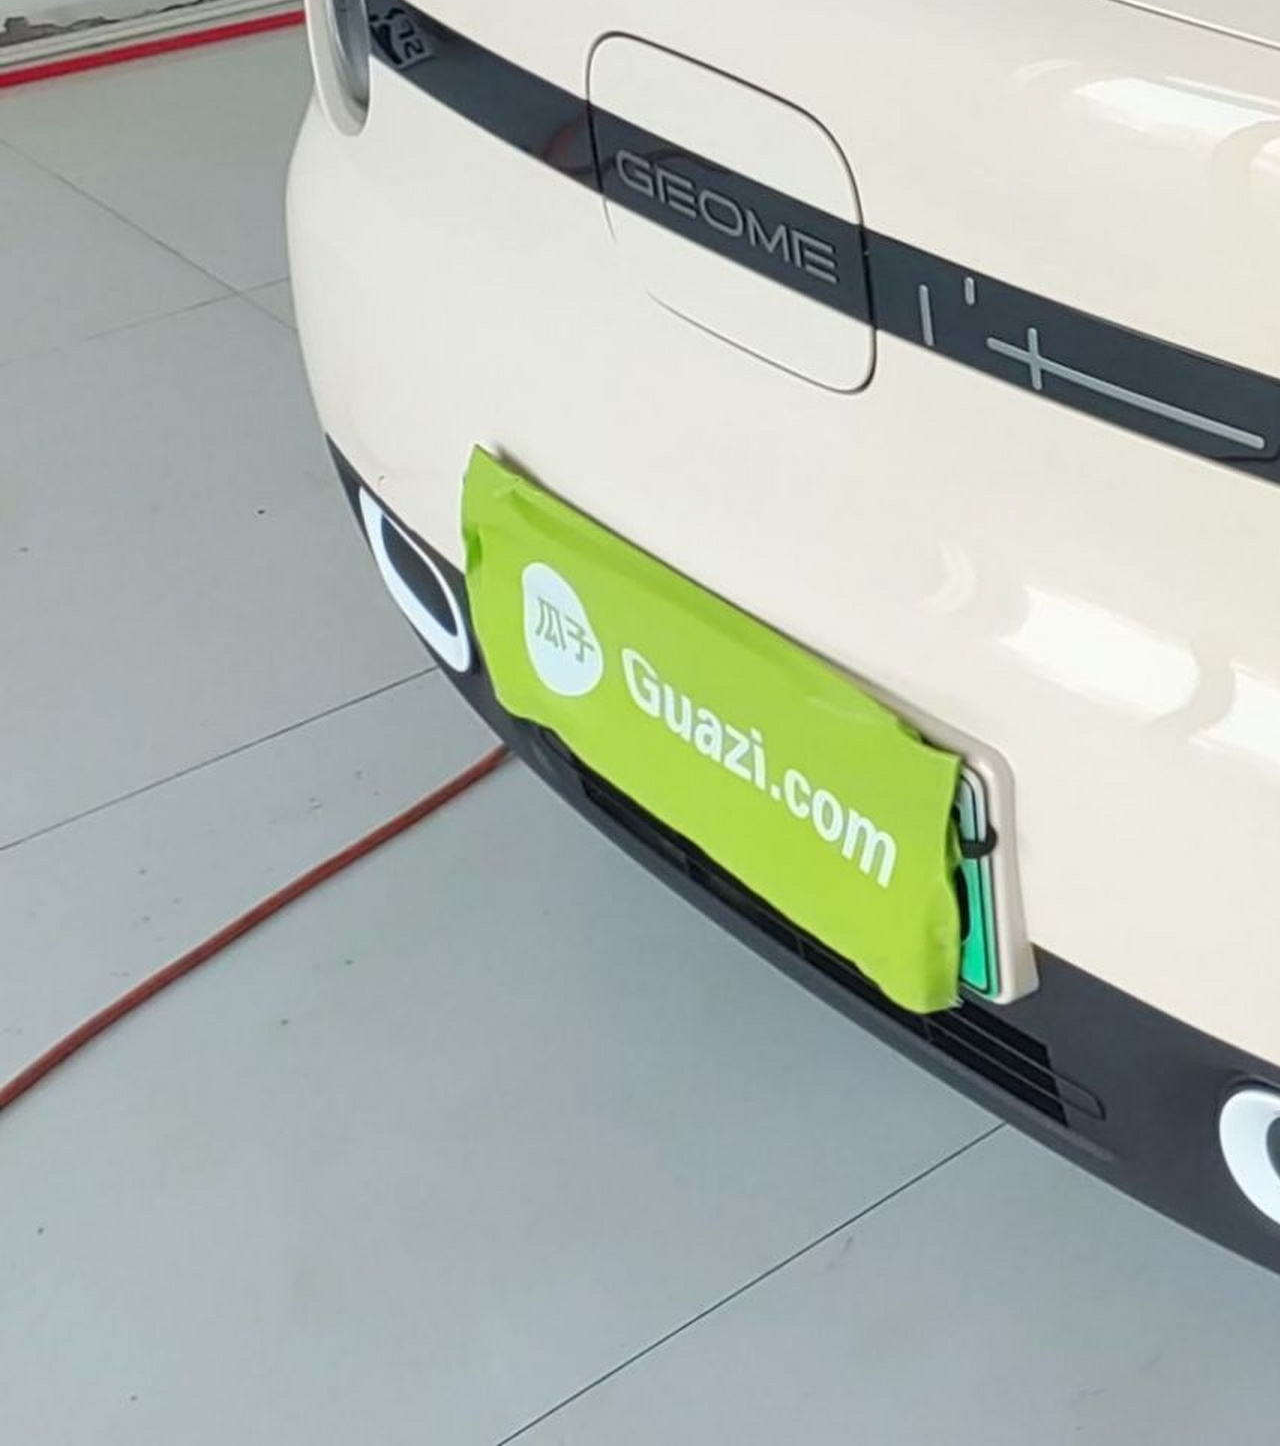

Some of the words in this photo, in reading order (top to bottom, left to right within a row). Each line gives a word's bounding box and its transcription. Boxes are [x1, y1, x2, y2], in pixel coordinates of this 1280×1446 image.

[615, 148, 840, 285] GEOME
[535, 596, 595, 663] 瓜子
[621, 646, 898, 890] Guazi.com
